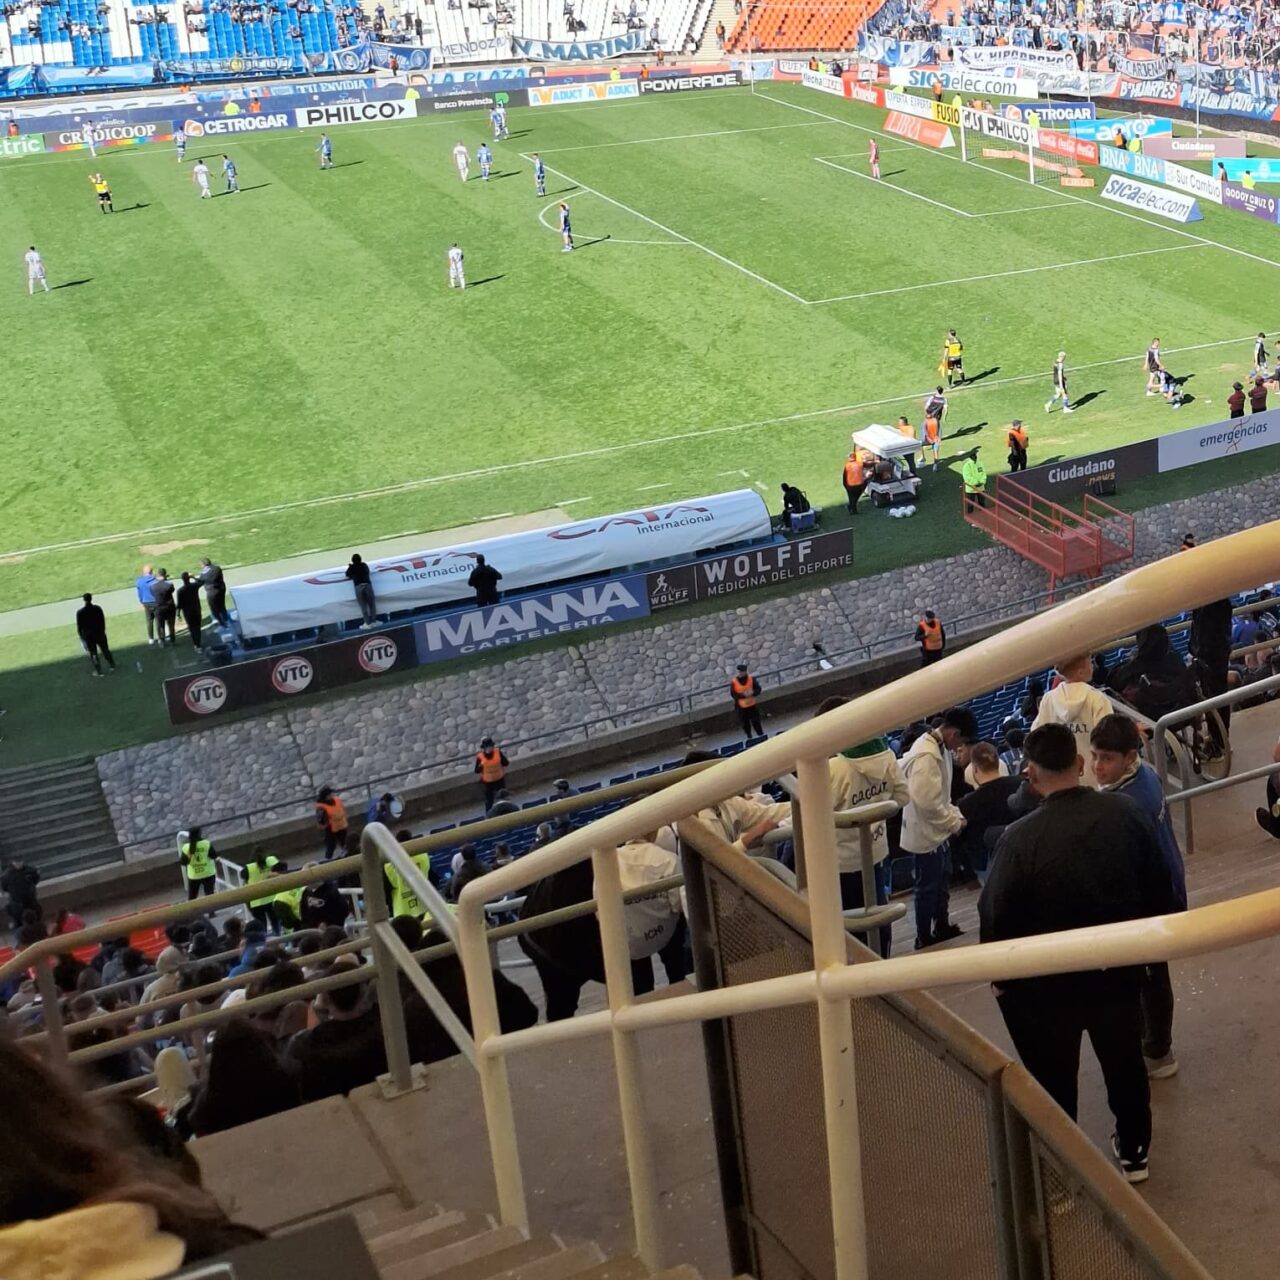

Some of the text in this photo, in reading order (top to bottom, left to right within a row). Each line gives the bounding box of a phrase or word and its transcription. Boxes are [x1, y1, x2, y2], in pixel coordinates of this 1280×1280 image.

[306, 102, 396, 126] PHILCO
[434, 97, 493, 110] Banco Provincia
[58, 124, 157, 145] CRDICOOP
[204, 113, 289, 134] CETROGAR
[1189, 174, 1221, 199] Cambio
[1199, 422, 1268, 448] emergencias
[1048, 457, 1116, 484] Ciudadano
[636, 513, 714, 535] Internacional
[401, 562, 475, 584] Internacion
[704, 540, 813, 584] WOLFF
[707, 553, 853, 597] MEDICINA DEL DEPORTE
[651, 589, 689, 606] WOLFF
[428, 582, 641, 653] MANNA
[459, 613, 615, 655] CARTELERÍA
[363, 644, 395, 663] VTC
[278, 664, 311, 683] VTC
[190, 685, 224, 704] VTC
